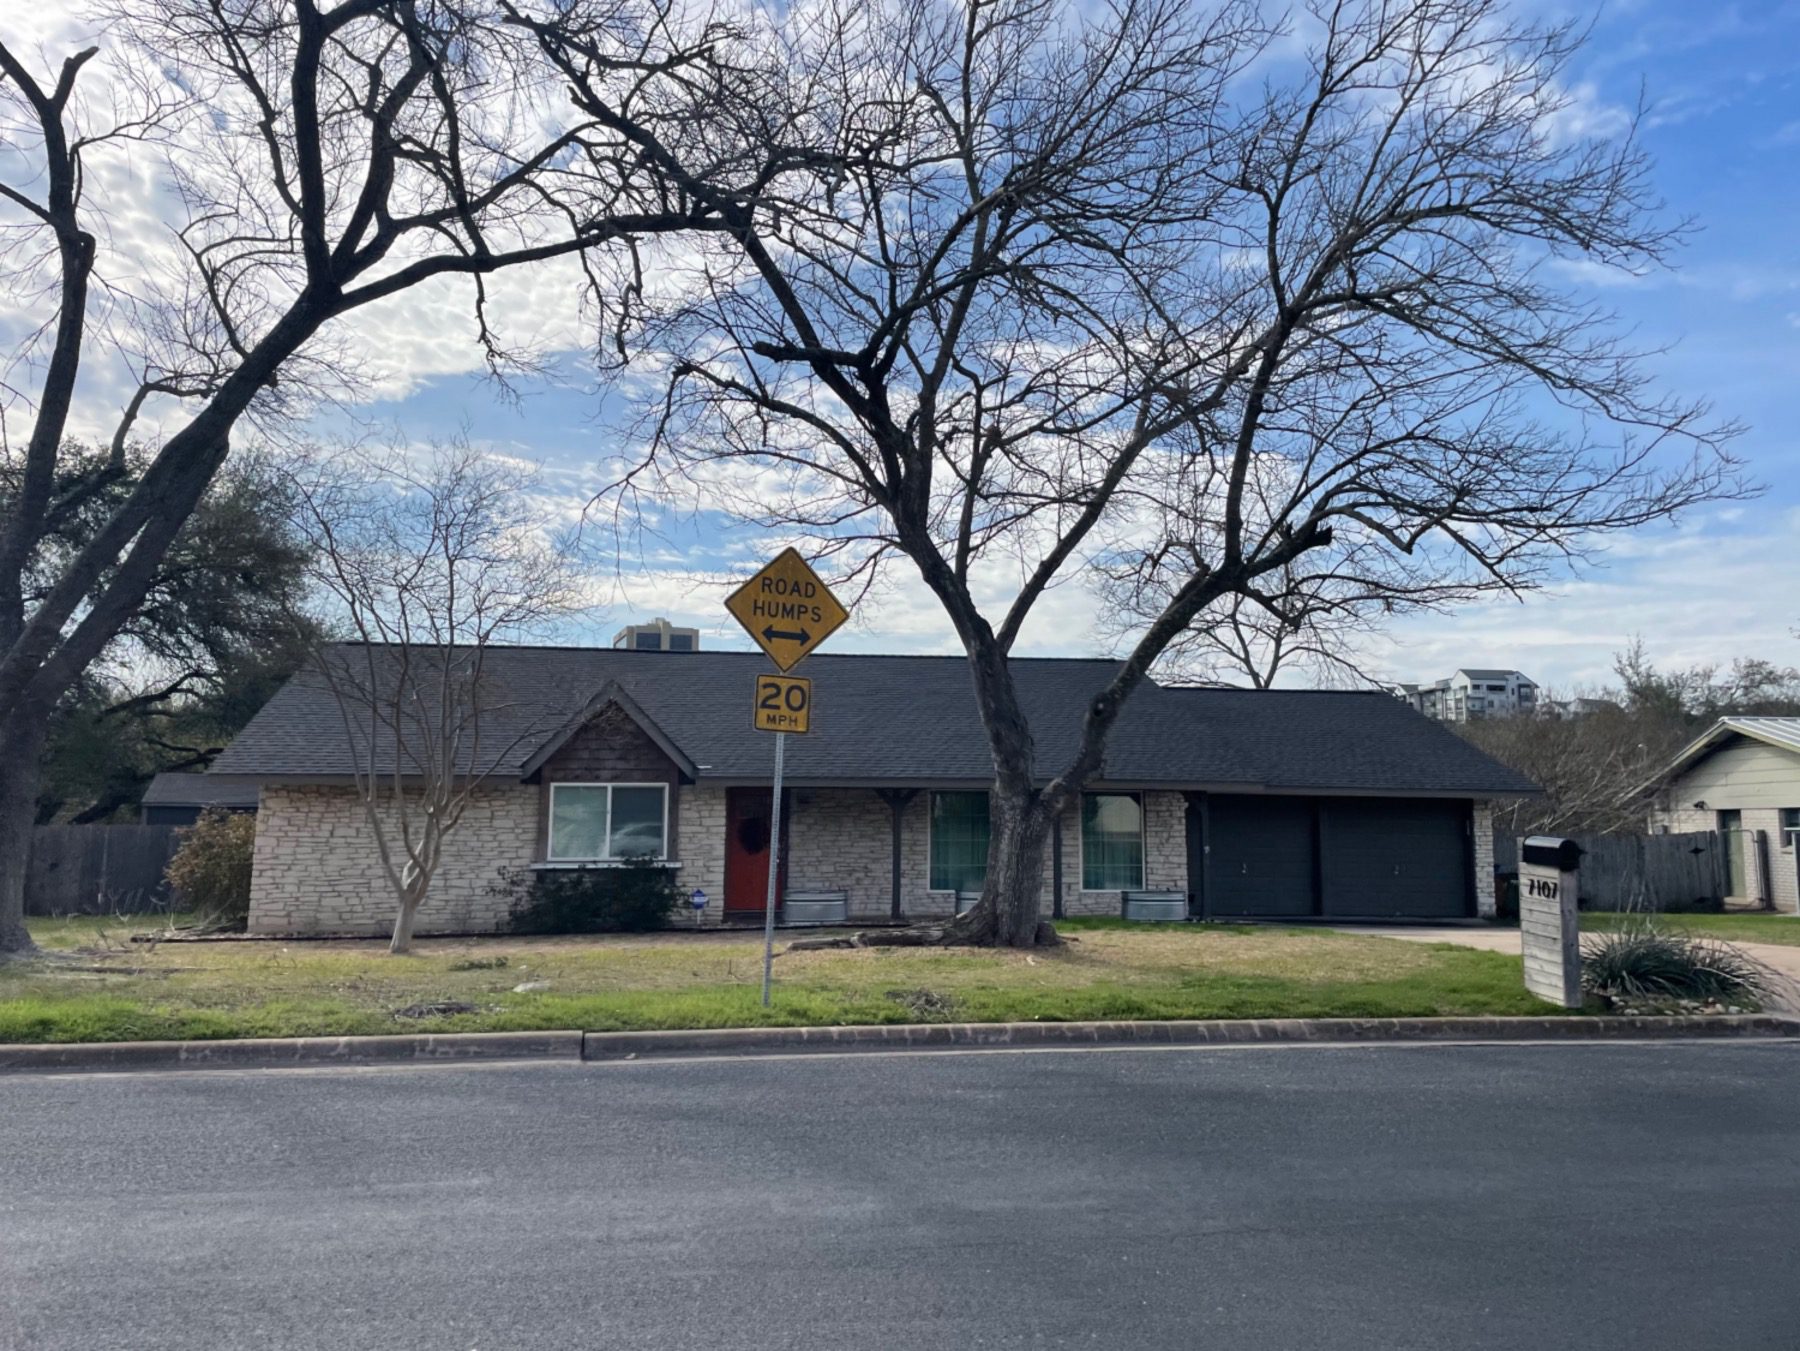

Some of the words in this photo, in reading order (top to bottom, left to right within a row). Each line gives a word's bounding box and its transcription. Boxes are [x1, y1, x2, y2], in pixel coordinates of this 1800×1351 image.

[761, 576, 816, 598] ROAD
[753, 599, 822, 623] HUMPS
[760, 683, 806, 712] 20
[766, 714, 798, 727] MPH
[1528, 879, 1558, 899] 7107
